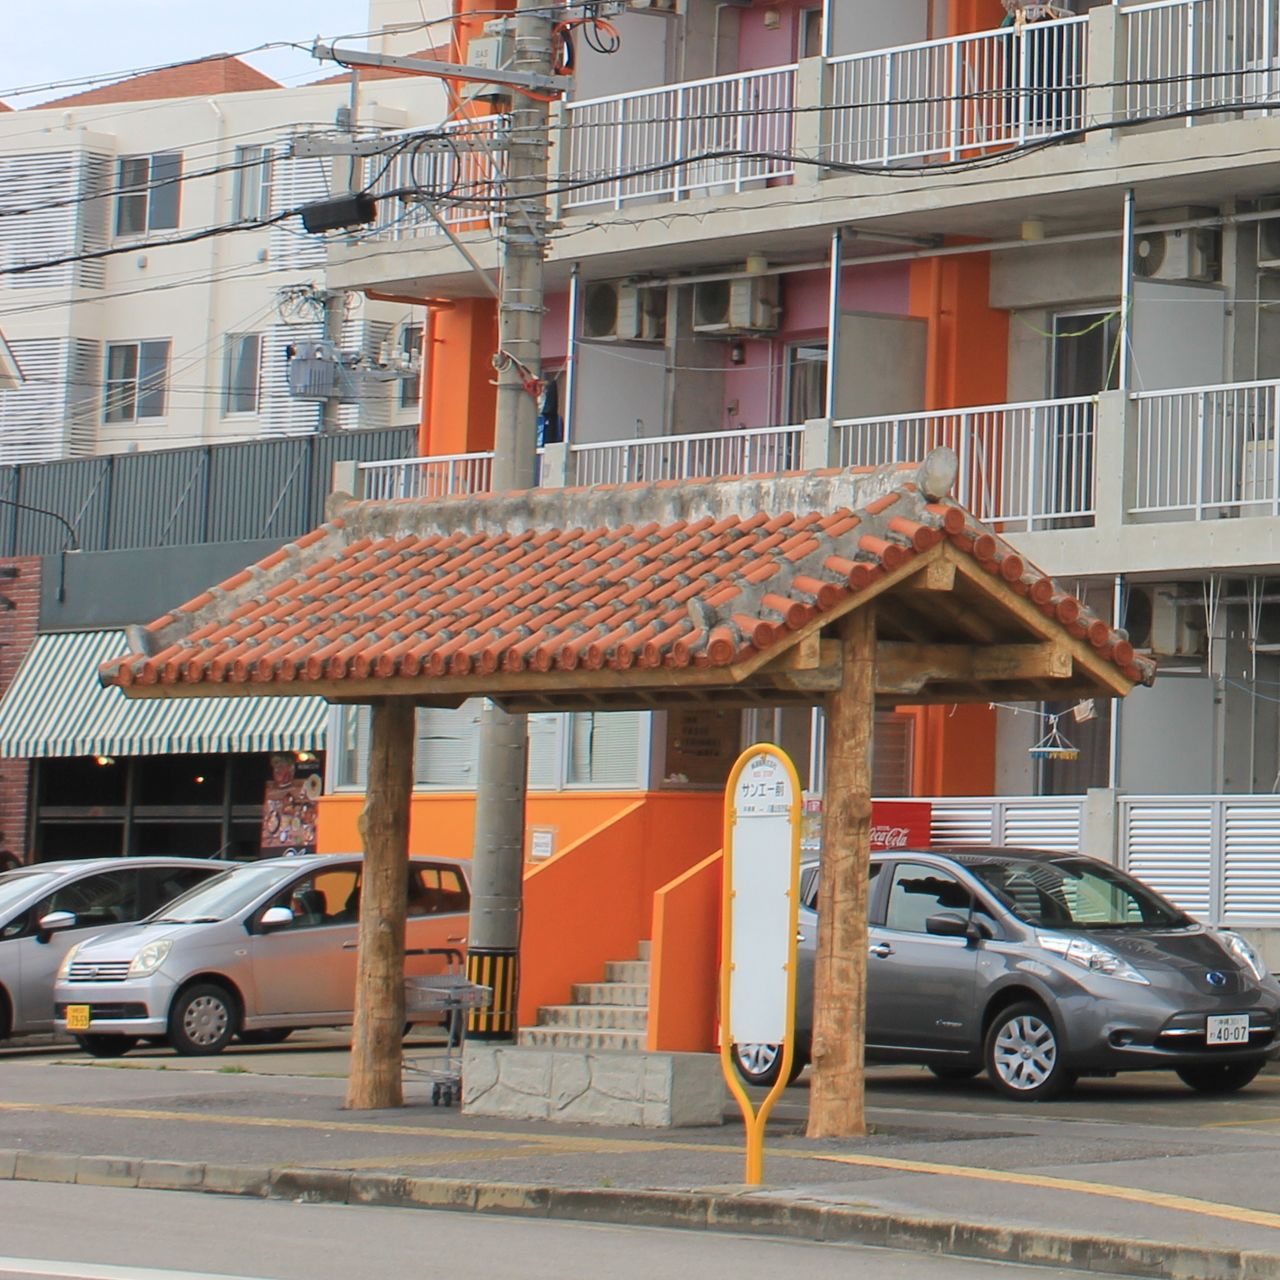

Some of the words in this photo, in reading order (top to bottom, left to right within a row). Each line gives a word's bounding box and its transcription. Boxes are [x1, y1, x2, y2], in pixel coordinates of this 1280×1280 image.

[742, 781, 785, 798] サンエー前
[1216, 1026, 1247, 1041] 40-07
